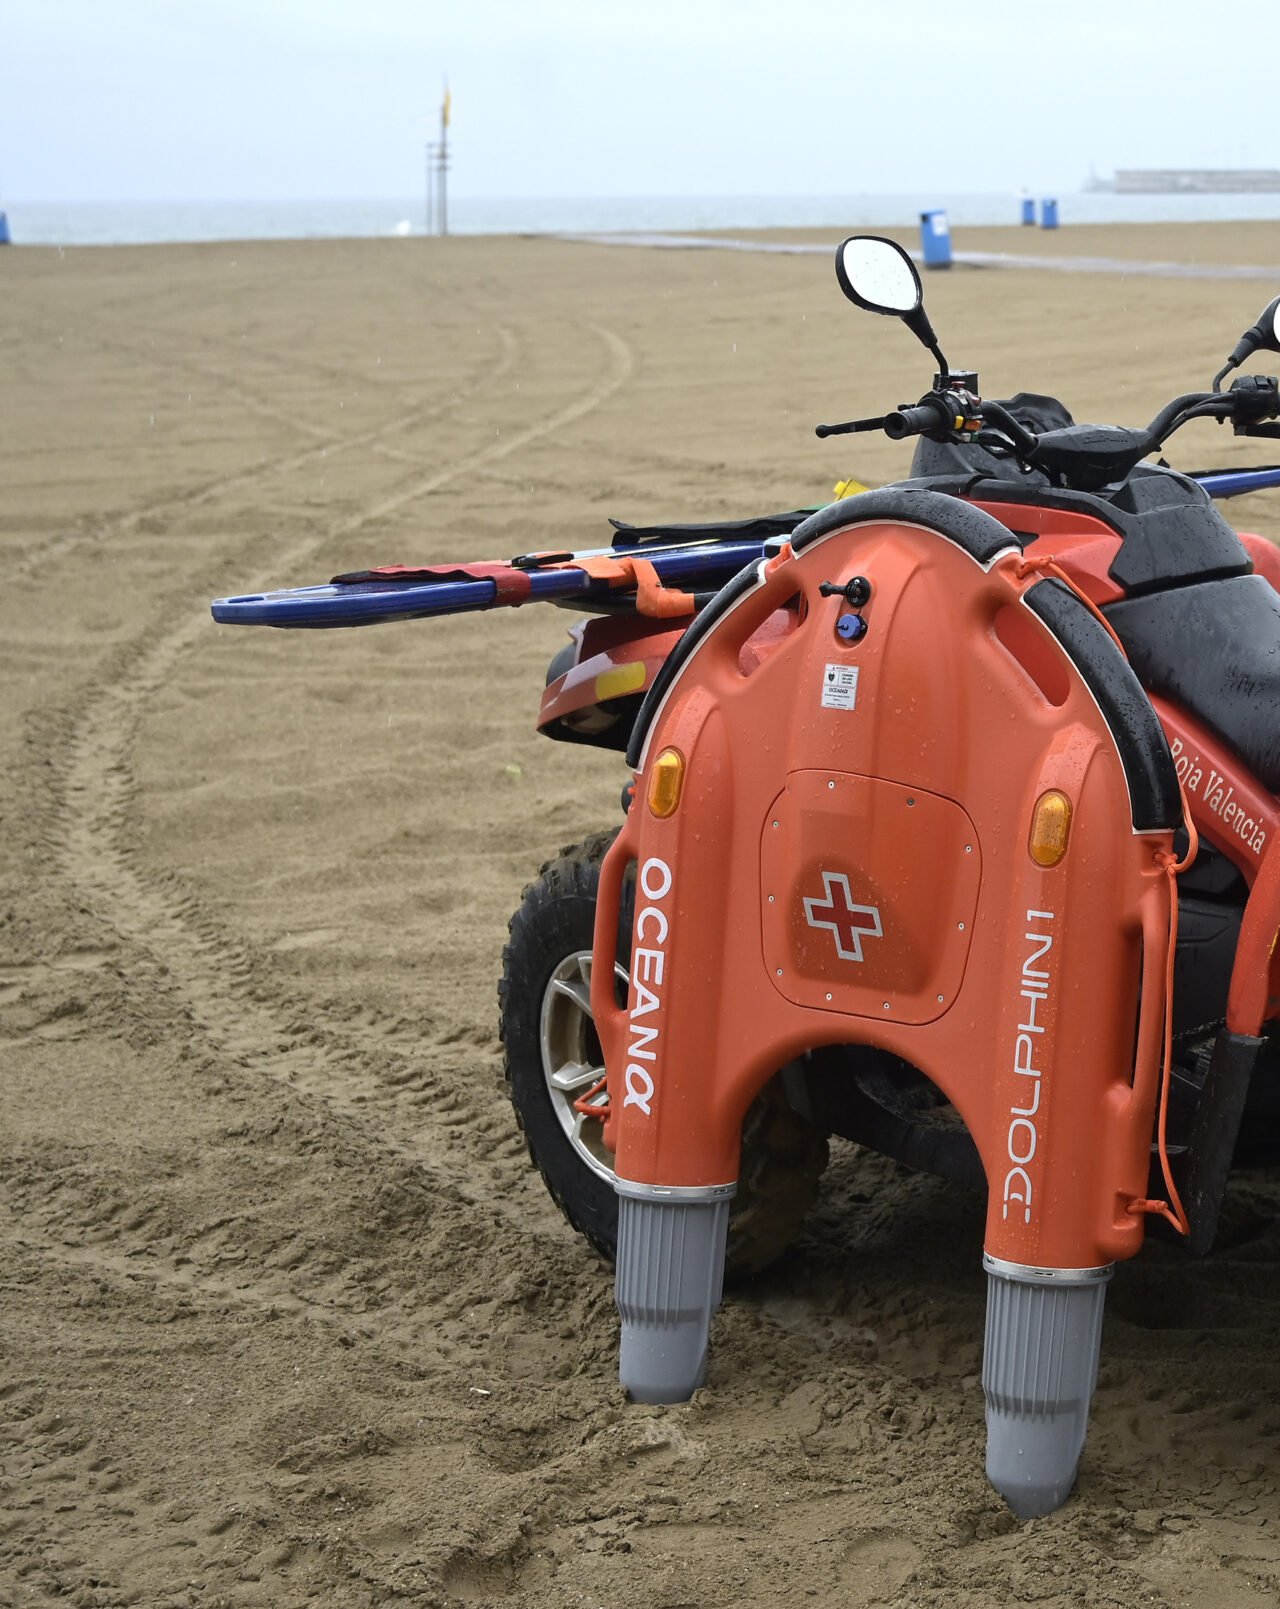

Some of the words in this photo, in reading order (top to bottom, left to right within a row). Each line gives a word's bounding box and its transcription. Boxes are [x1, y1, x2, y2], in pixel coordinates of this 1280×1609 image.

[1170, 737, 1203, 792] Roja
[1203, 770, 1267, 855] Valencia
[1002, 932, 1053, 1224] DOLPHIN
